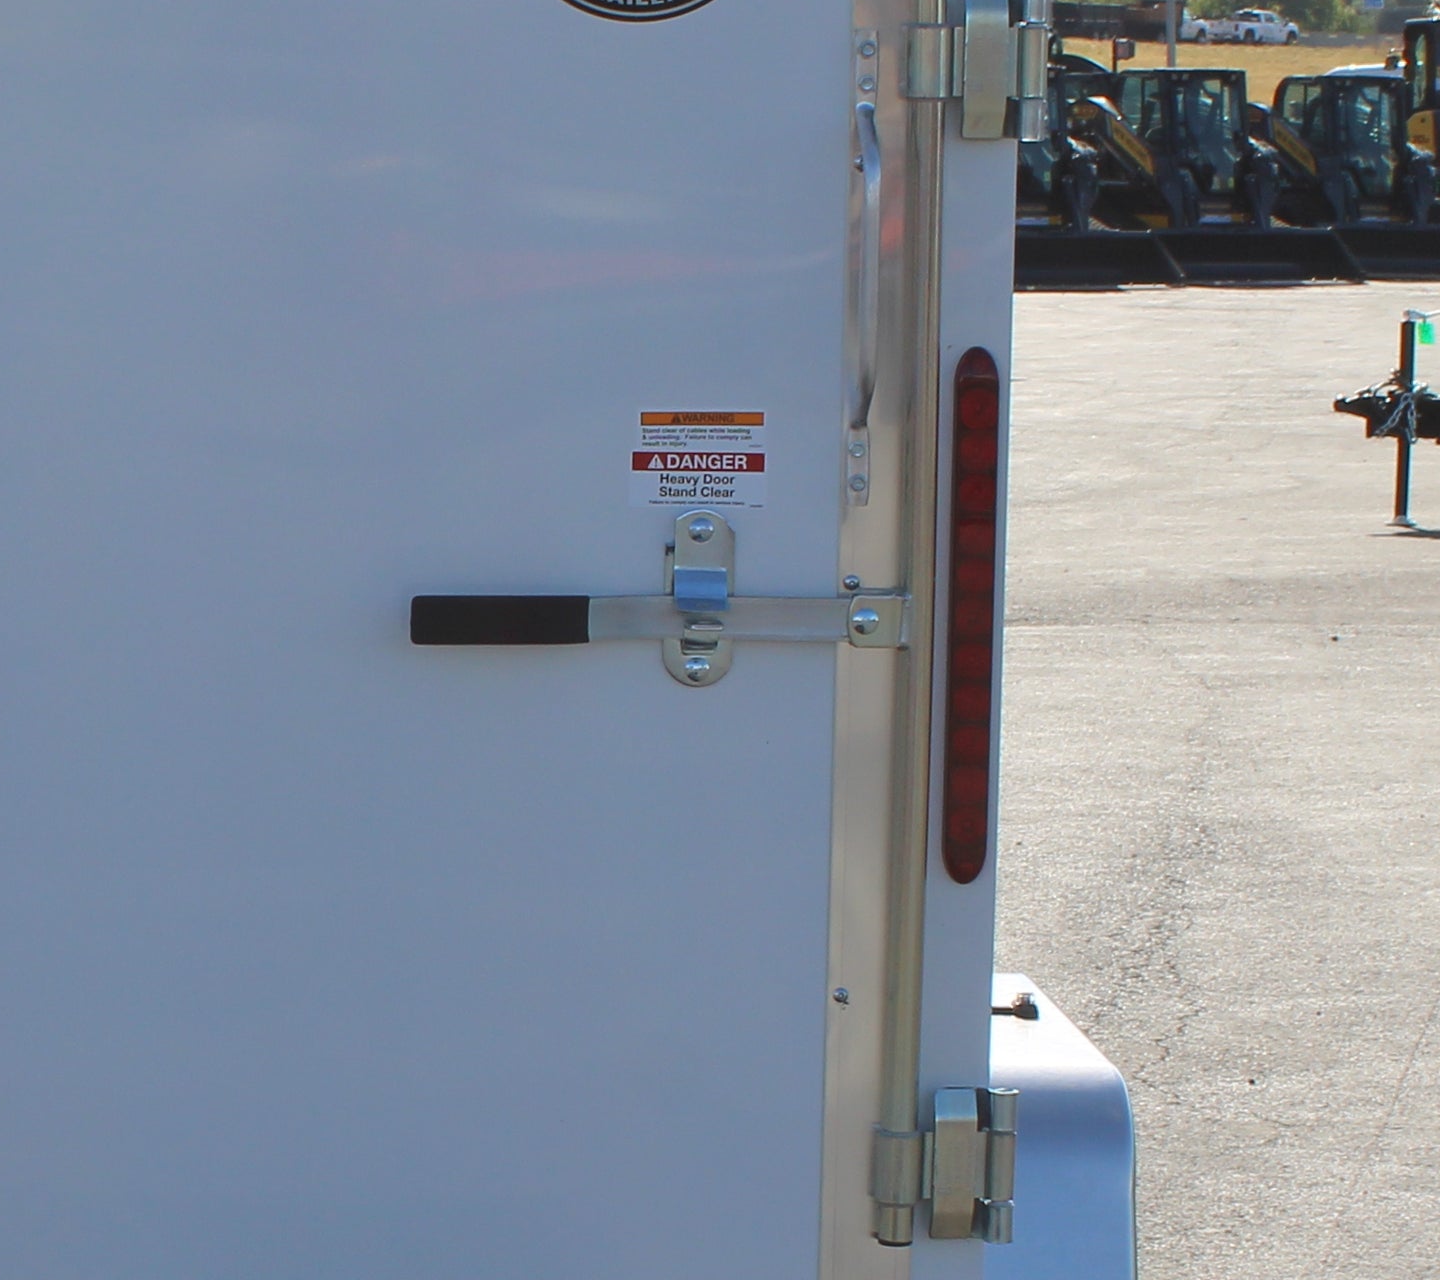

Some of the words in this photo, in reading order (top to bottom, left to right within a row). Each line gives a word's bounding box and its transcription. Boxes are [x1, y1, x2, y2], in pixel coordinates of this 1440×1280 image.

[682, 414, 735, 424] WARNING
[666, 454, 747, 470] DANGER
[659, 473, 700, 486] Heavy
[703, 473, 736, 485] Door
[659, 486, 697, 497] Stand
[700, 486, 736, 498] Clear
